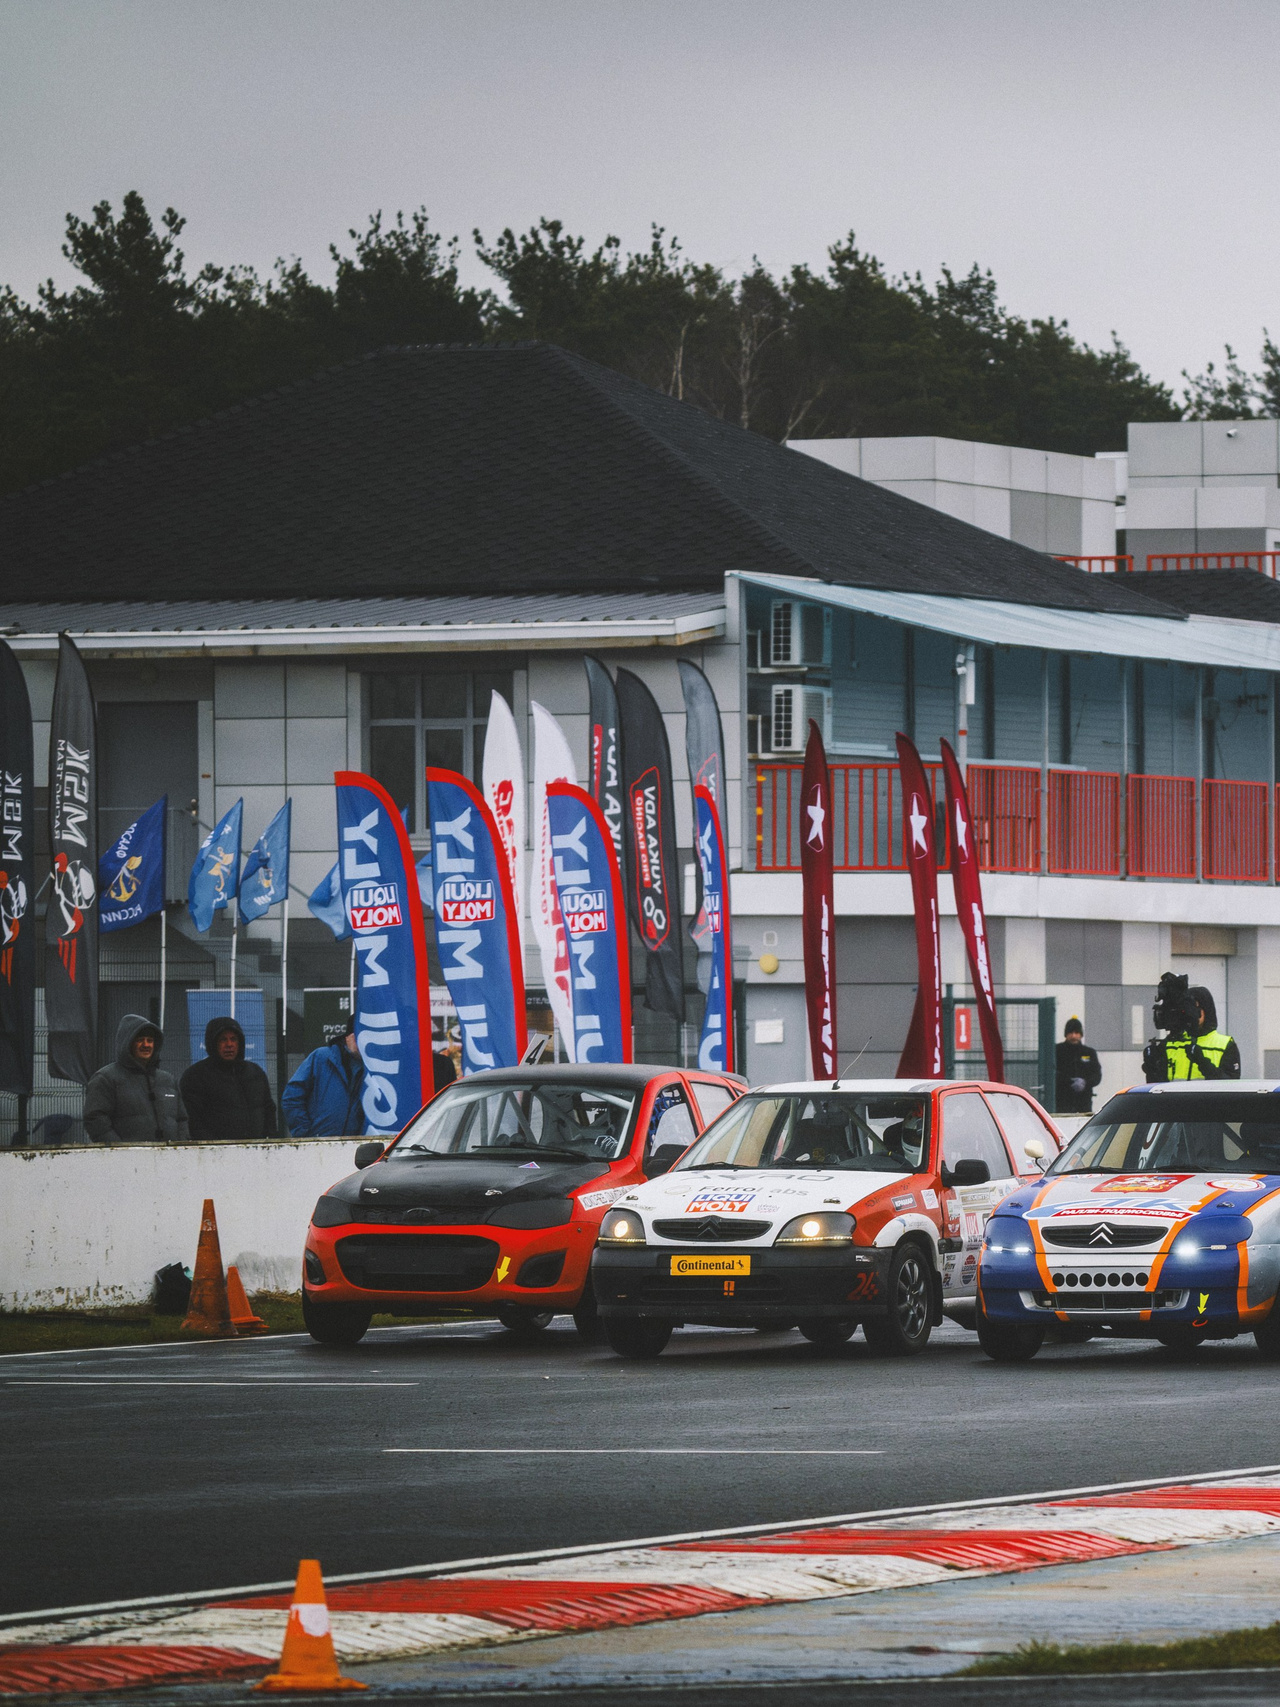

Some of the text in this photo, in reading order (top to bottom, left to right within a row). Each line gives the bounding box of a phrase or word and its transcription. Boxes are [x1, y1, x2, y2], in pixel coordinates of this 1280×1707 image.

[694, 1194, 754, 1202] LIQUI
[688, 1201, 749, 1213] MOLY
[677, 1259, 735, 1273] Continental
